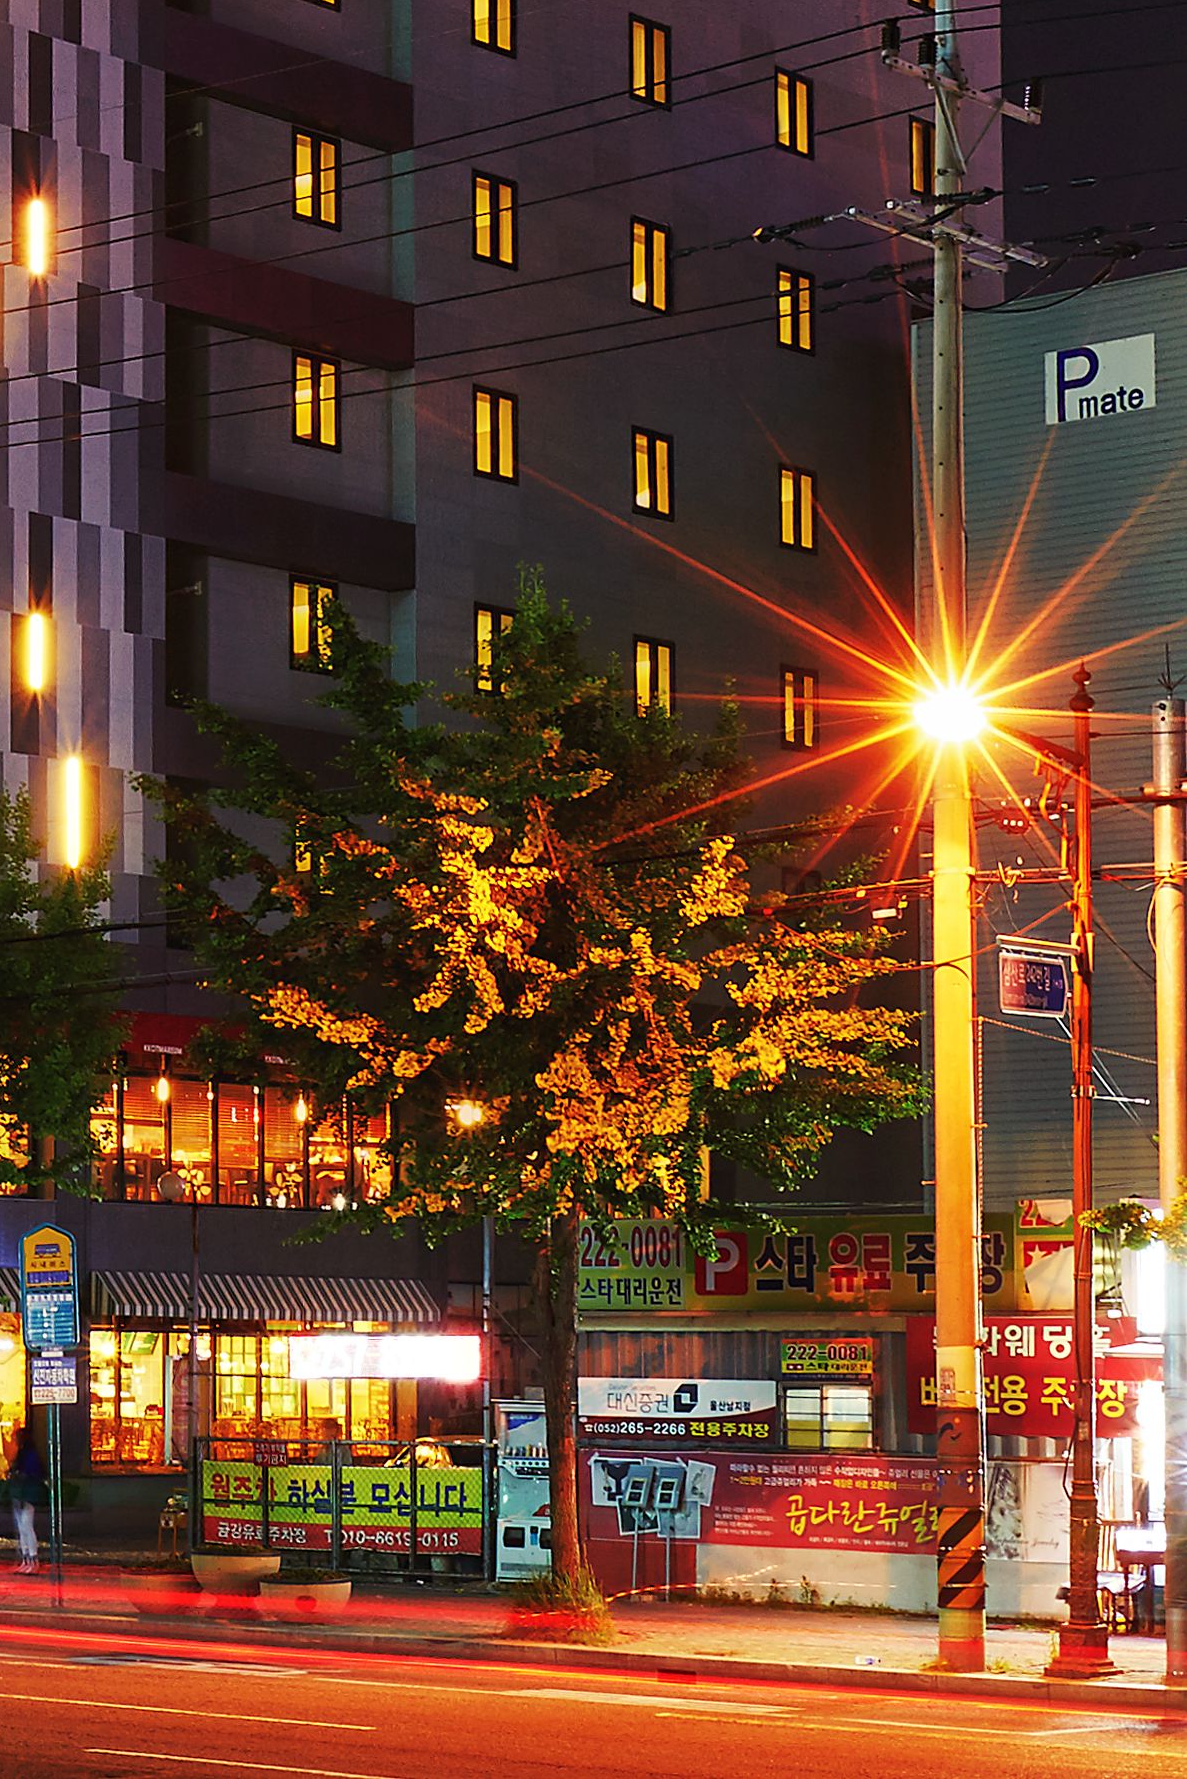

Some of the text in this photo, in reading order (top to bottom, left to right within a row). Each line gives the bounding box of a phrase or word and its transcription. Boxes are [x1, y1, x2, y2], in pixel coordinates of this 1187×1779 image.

[754, 1233, 1006, 1295] 스타 유료 주장
[580, 1277, 682, 1305] 스타대리운전
[787, 1345, 867, 1360] 222-0081
[607, 1392, 669, 1413] 대신증권
[594, 1421, 770, 1438] (052)265-2266 전용주차장
